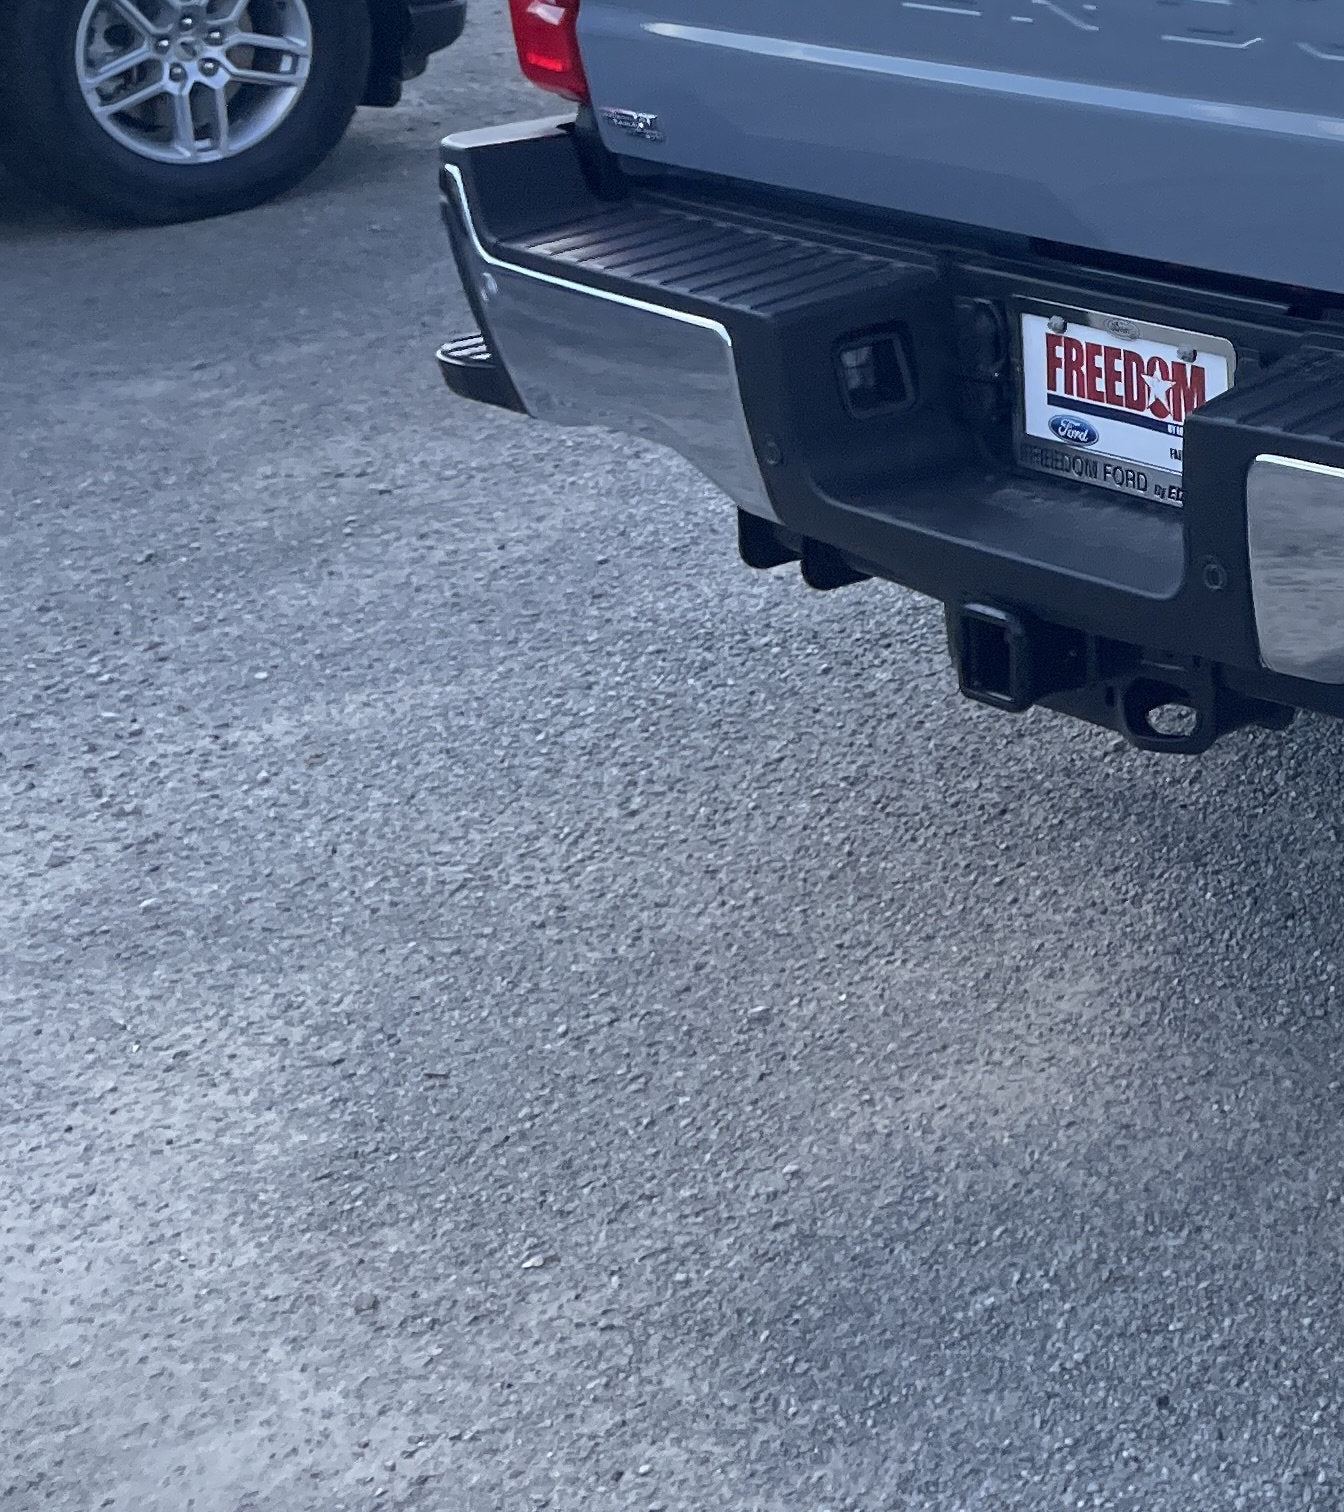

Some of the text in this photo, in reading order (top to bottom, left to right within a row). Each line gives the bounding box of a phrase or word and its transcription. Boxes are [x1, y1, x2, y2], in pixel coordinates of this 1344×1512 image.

[1046, 333, 1206, 422] FREEDOM
[1058, 419, 1088, 441] Ford
[1103, 462, 1148, 492] FORD
